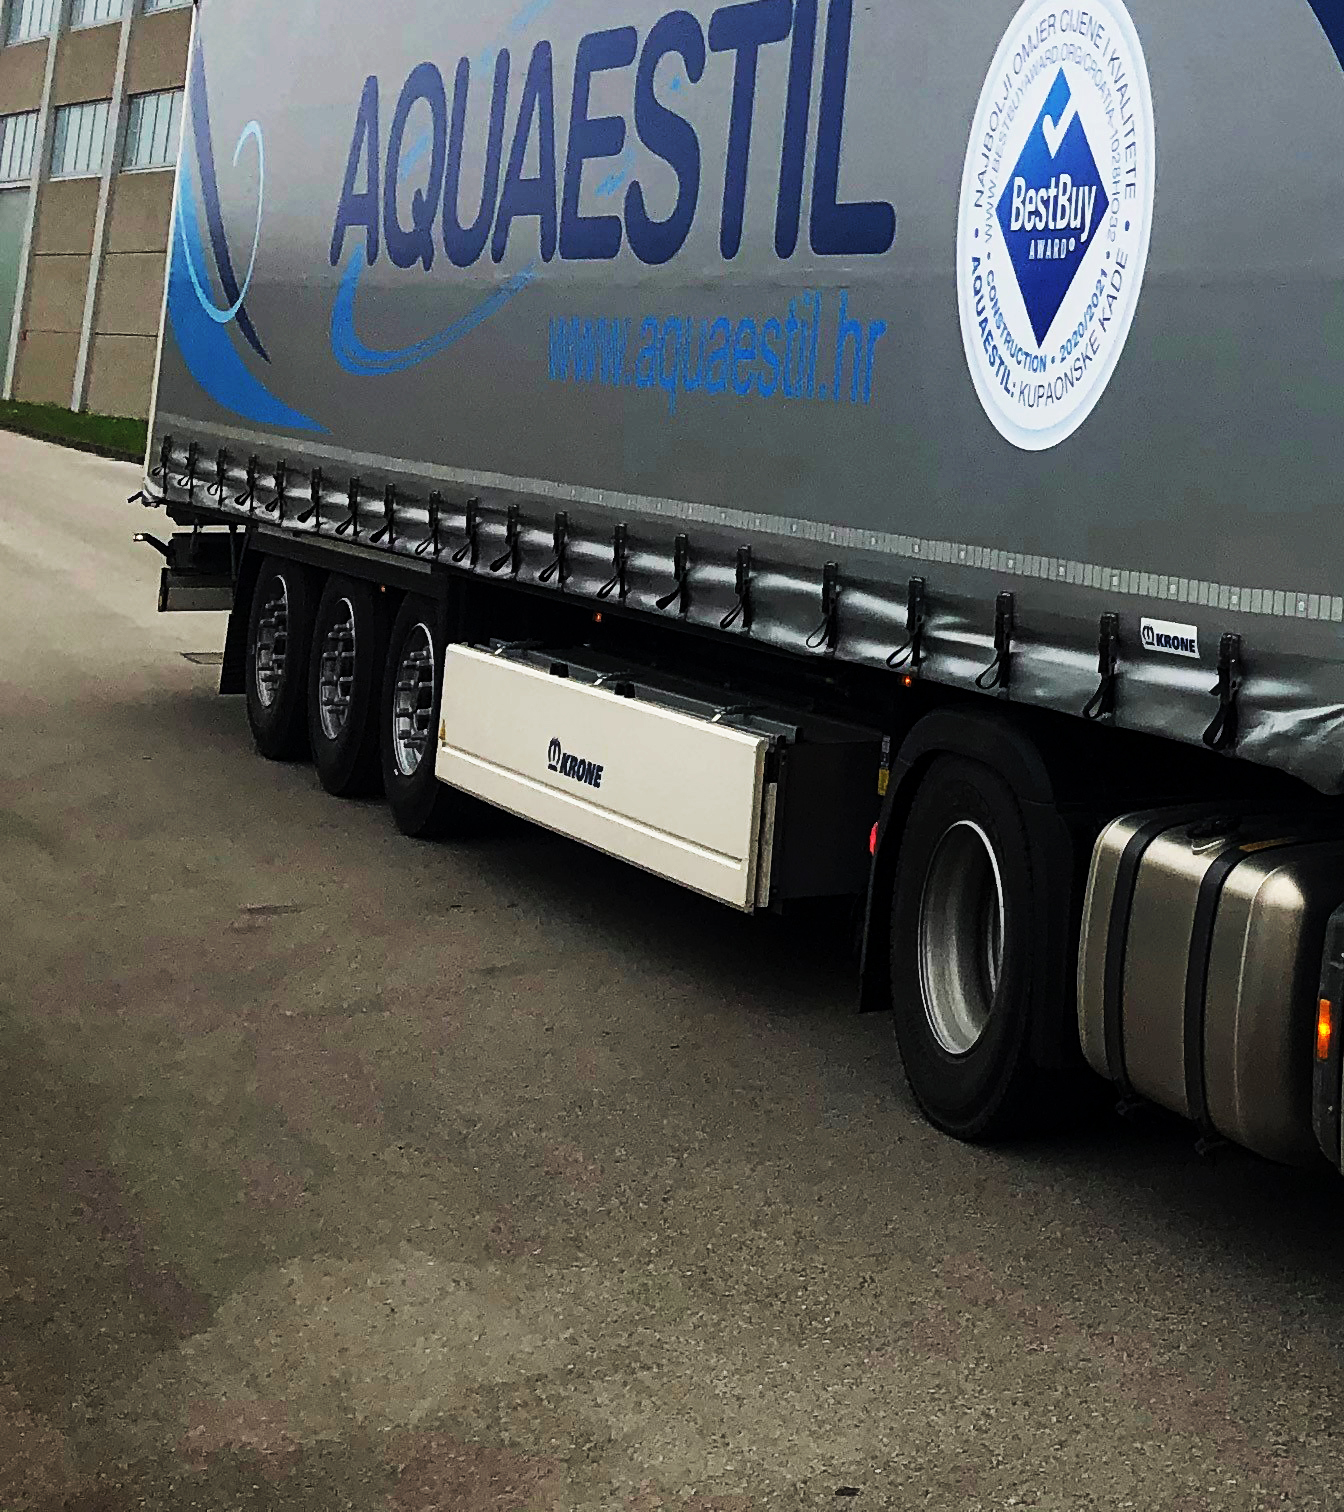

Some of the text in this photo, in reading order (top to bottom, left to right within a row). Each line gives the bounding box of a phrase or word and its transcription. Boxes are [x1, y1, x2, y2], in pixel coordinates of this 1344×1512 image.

[974, 73, 1013, 208] NAJBOLJI
[1012, 13, 1056, 75] OMJER
[1060, 9, 1106, 50] CIJENE
[1107, 51, 1138, 200] KVALITETE
[1010, 173, 1097, 242] BestBuy
[548, 292, 886, 416] www.aquaestil.hr
[971, 248, 1129, 408] AQUAESTIL: KUPAONSKE KADE
[987, 270, 1047, 373] CONSTRUCTION
[1059, 268, 1108, 364] 2020/2021
[1155, 633, 1196, 653] KRONE
[559, 753, 604, 788] KRONE
